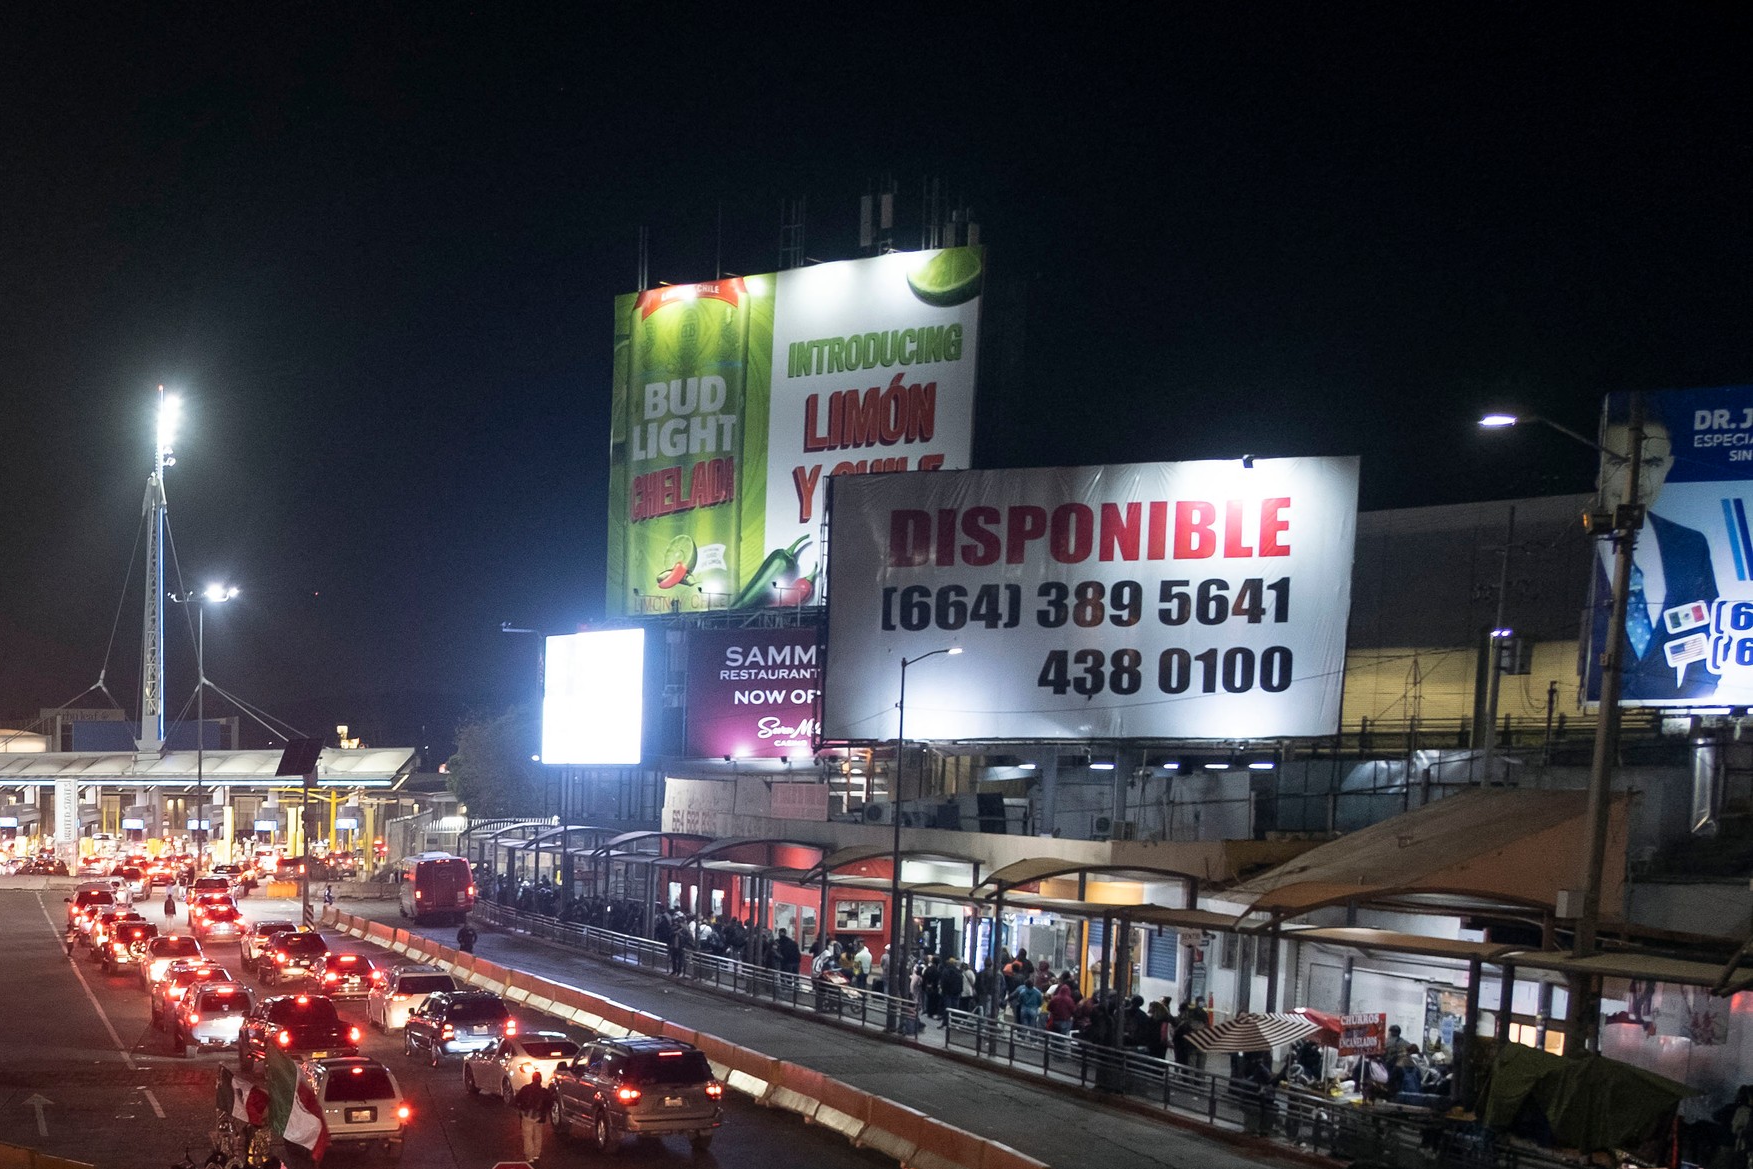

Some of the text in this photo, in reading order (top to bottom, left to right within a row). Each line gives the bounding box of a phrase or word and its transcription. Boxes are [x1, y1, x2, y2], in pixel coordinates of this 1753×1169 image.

[787, 323, 963, 378] INTRODUCING
[644, 375, 727, 420] BUD
[803, 372, 937, 453] LIMÓN
[1693, 409, 1737, 431] DR.
[633, 414, 736, 460] LIGHT
[631, 456, 735, 523] CHELADA
[792, 464, 822, 524] Y
[889, 497, 1292, 568] DISPONIBLE
[1036, 580, 1143, 628] 389
[1158, 577, 1292, 626] 5641
[726, 645, 826, 667] SAMM
[1037, 646, 1293, 696] 438 0100
[734, 690, 787, 705] NOW
[1340, 1014, 1379, 1025] CHURROS
